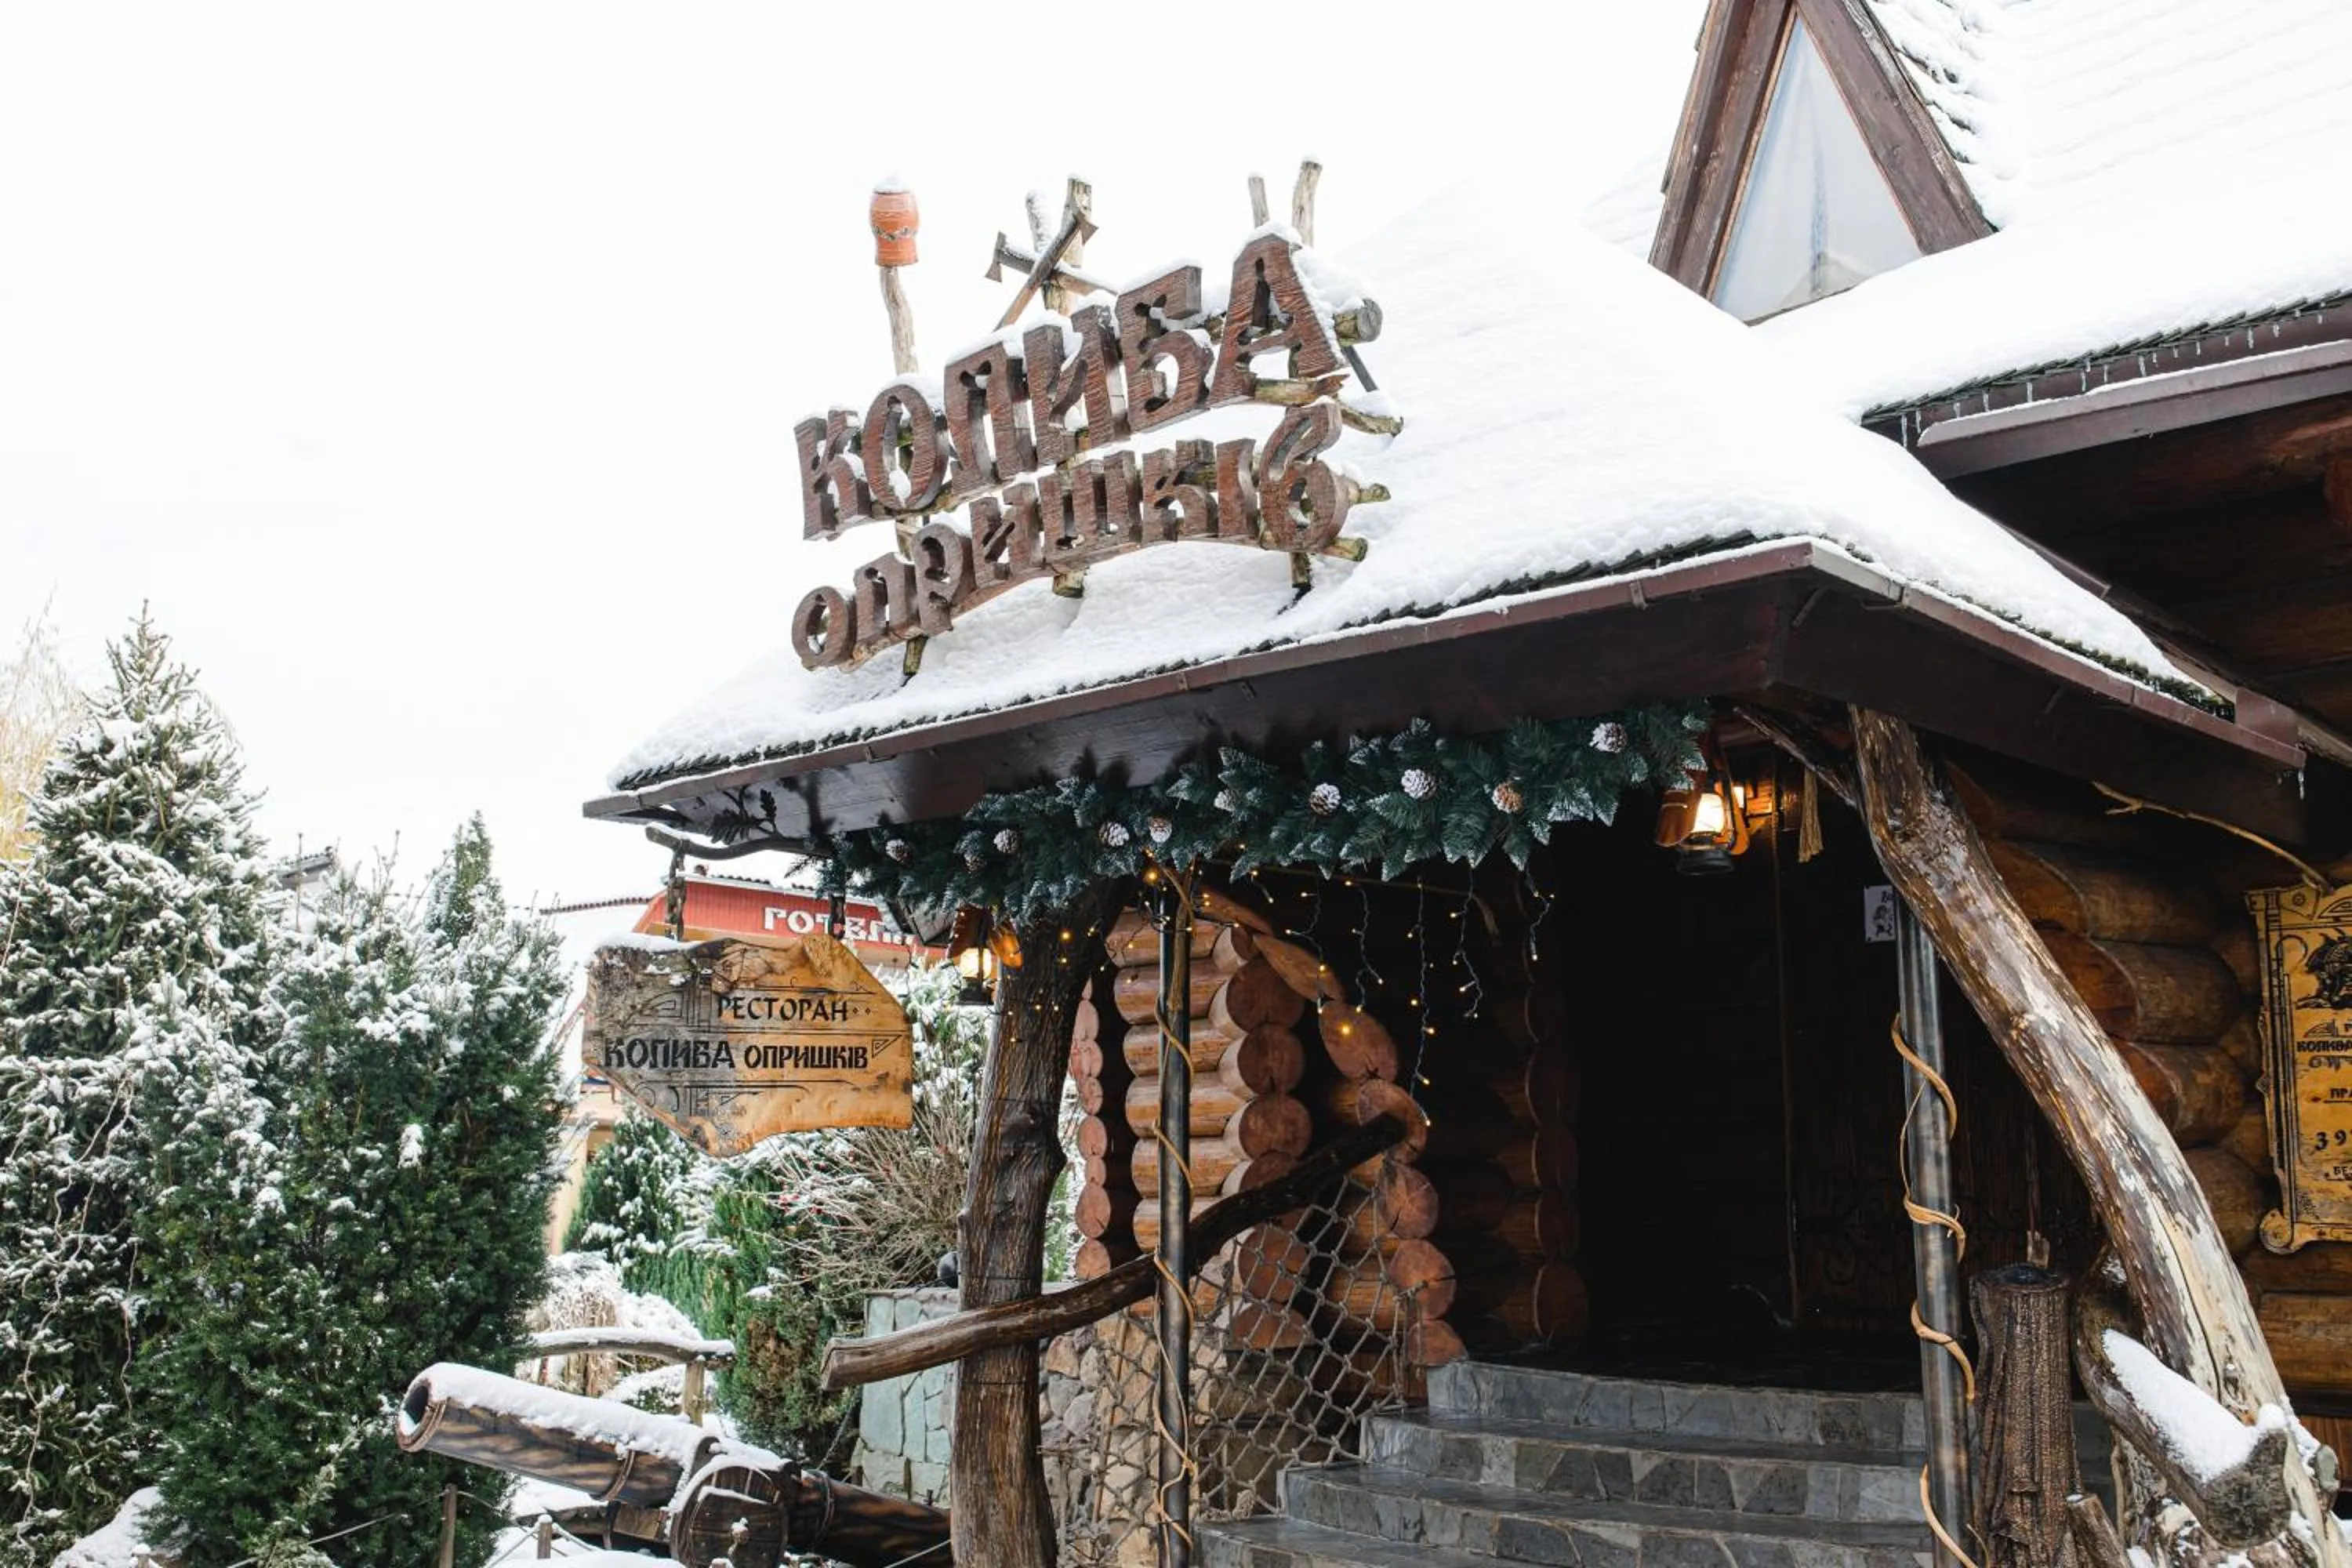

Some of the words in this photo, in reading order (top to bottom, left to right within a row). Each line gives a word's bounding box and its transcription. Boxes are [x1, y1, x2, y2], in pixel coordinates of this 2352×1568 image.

[793, 234, 1348, 541] КОЛИБА
[717, 996, 848, 1022] РЕСТОРАН
[604, 1036, 736, 1069] КОЛИБА
[744, 1045, 868, 1069] ОПРИШКІВ
